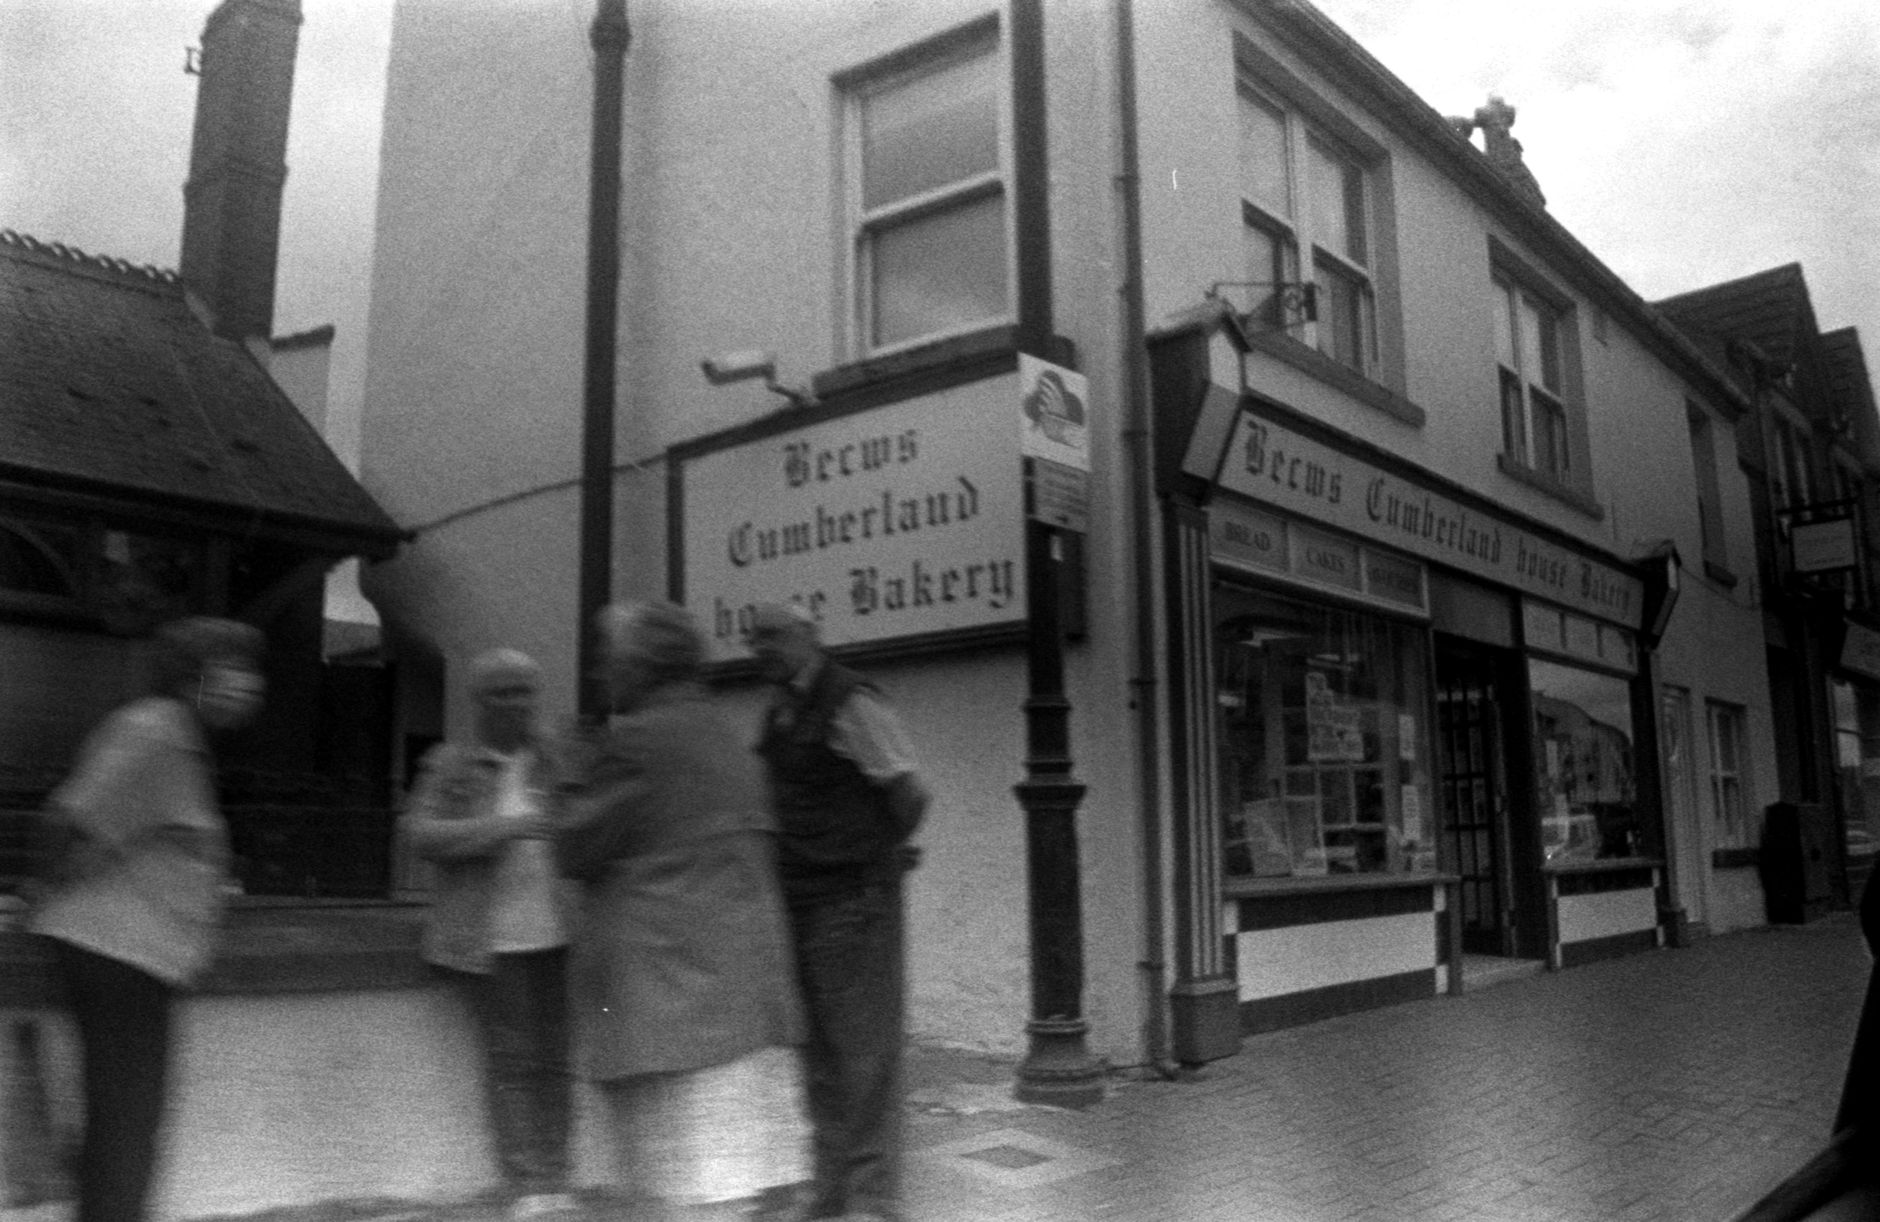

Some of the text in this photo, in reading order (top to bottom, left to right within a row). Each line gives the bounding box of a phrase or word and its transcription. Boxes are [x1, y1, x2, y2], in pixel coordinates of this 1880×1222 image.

[783, 429, 918, 488] Becws
[727, 475, 979, 567] Cumberland
[1245, 419, 1342, 504] Becws
[1366, 476, 1501, 564] Cumberland
[1580, 561, 1630, 620] Bakery
[713, 559, 1014, 640] hoe Bakery
